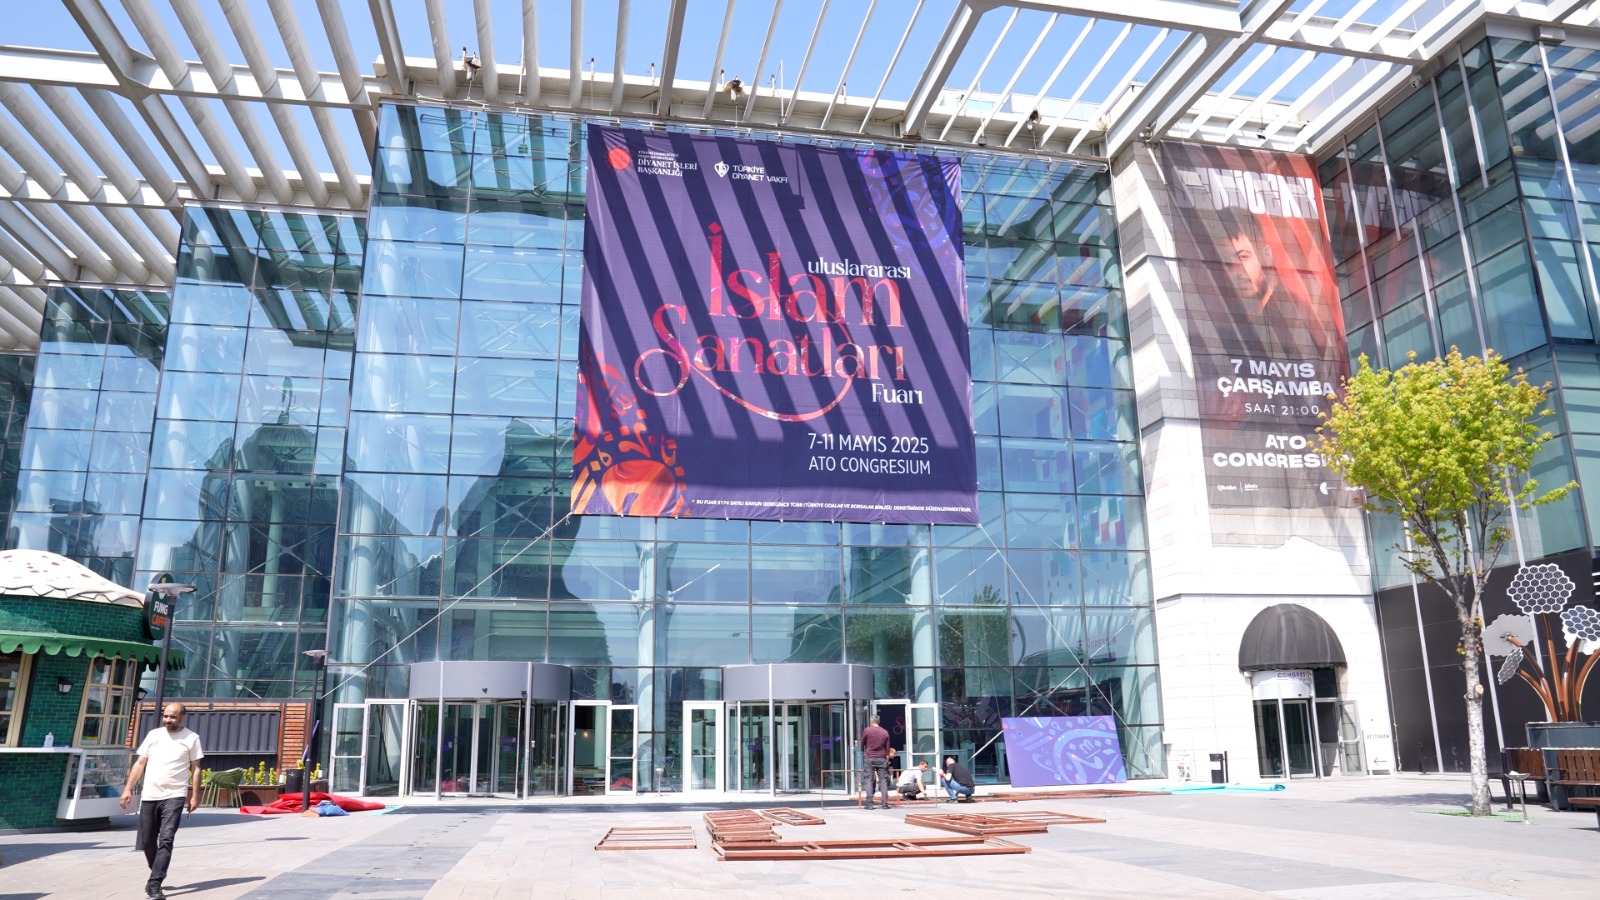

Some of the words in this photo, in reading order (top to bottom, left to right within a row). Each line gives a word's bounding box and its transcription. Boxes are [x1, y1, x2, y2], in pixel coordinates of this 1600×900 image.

[637, 158, 672, 168] DİYANET
[673, 160, 698, 171] İŞLERİ
[637, 167, 683, 177] BAŞKANLIĞI
[732, 164, 765, 174] TÜRKİYE
[731, 173, 765, 181] DİYANET
[708, 222, 905, 328] İslam
[808, 257, 911, 279] uluslararası
[634, 302, 906, 422] Sanatları
[1230, 359, 1243, 374] 7
[1249, 360, 1316, 378] MAYIS
[872, 383, 923, 405] Fuarı
[1217, 377, 1336, 399] ÇARŞAMBA
[1245, 403, 1276, 414] SAAT
[1281, 405, 1320, 416] 21:00
[808, 433, 835, 450] 7-11
[839, 434, 887, 453] MAYIS
[891, 436, 929, 454] 2025
[1265, 434, 1307, 450] ATO
[809, 456, 837, 472] ATO
[840, 457, 931, 475] CONGRESIUM
[1212, 452, 1356, 469] CONGRESI
